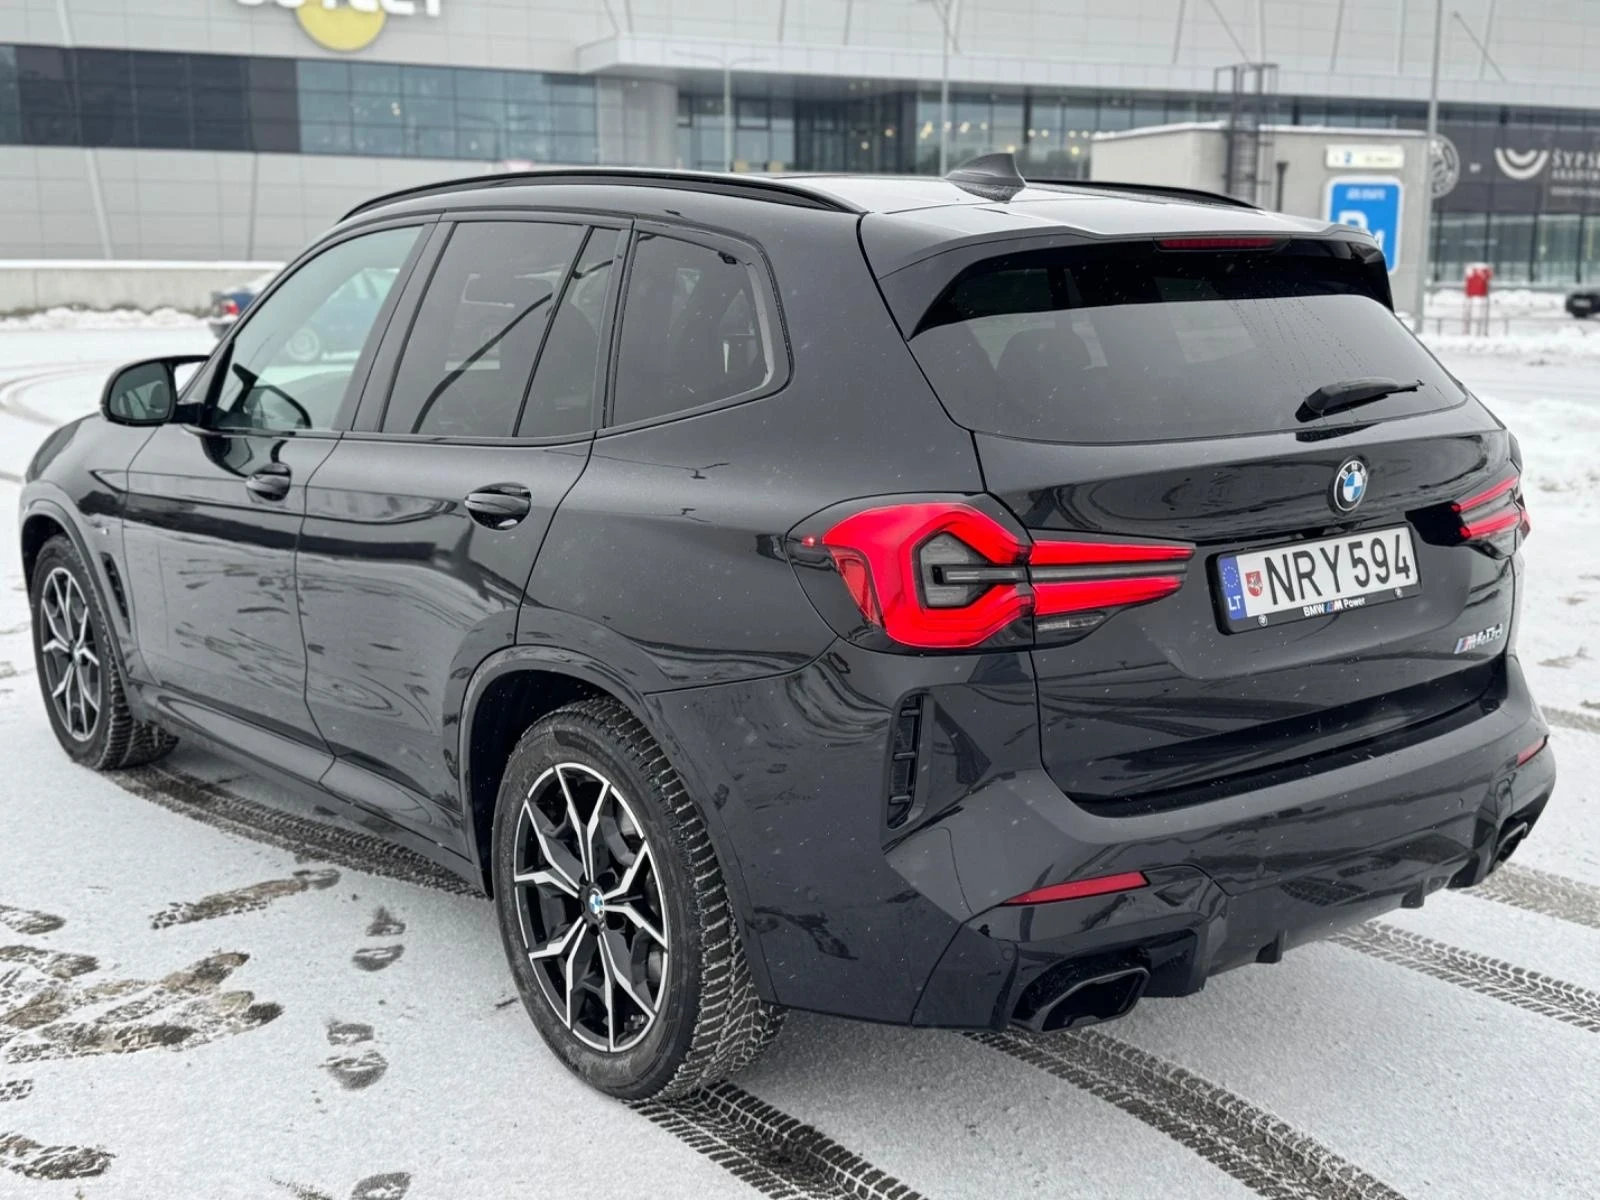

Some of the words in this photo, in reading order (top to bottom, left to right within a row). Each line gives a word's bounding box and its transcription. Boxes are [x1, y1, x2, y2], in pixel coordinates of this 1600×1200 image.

[1228, 595, 1241, 611] LT
[1303, 603, 1325, 617] BMW
[1343, 597, 1366, 608] Power
